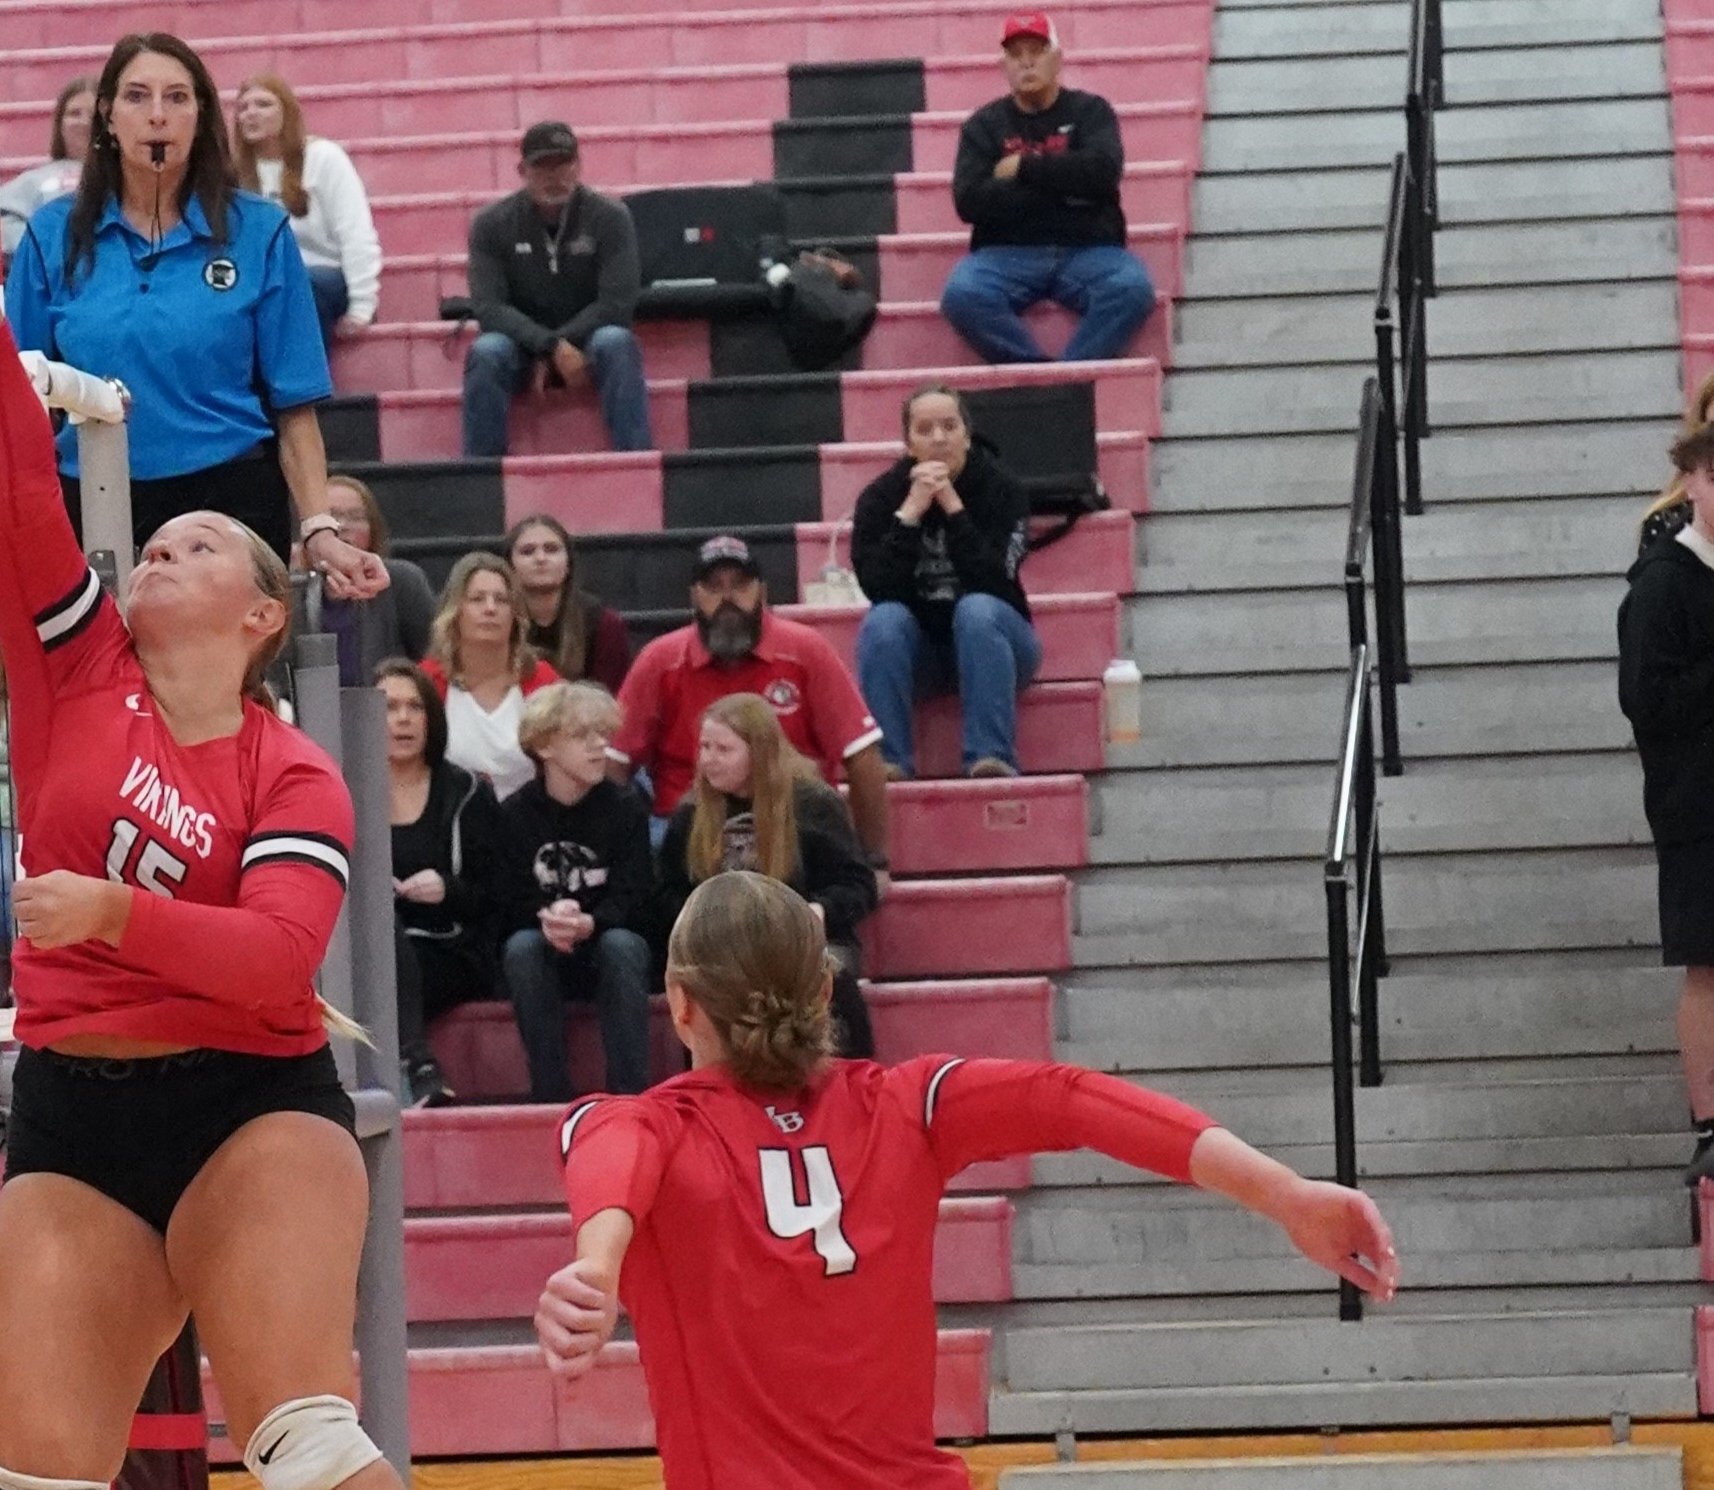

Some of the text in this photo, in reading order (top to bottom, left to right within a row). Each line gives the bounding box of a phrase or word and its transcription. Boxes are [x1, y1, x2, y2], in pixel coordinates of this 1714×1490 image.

[106, 817, 187, 899] 15
[119, 756, 216, 859] VIKINGS
[758, 1145, 857, 1278] 4
